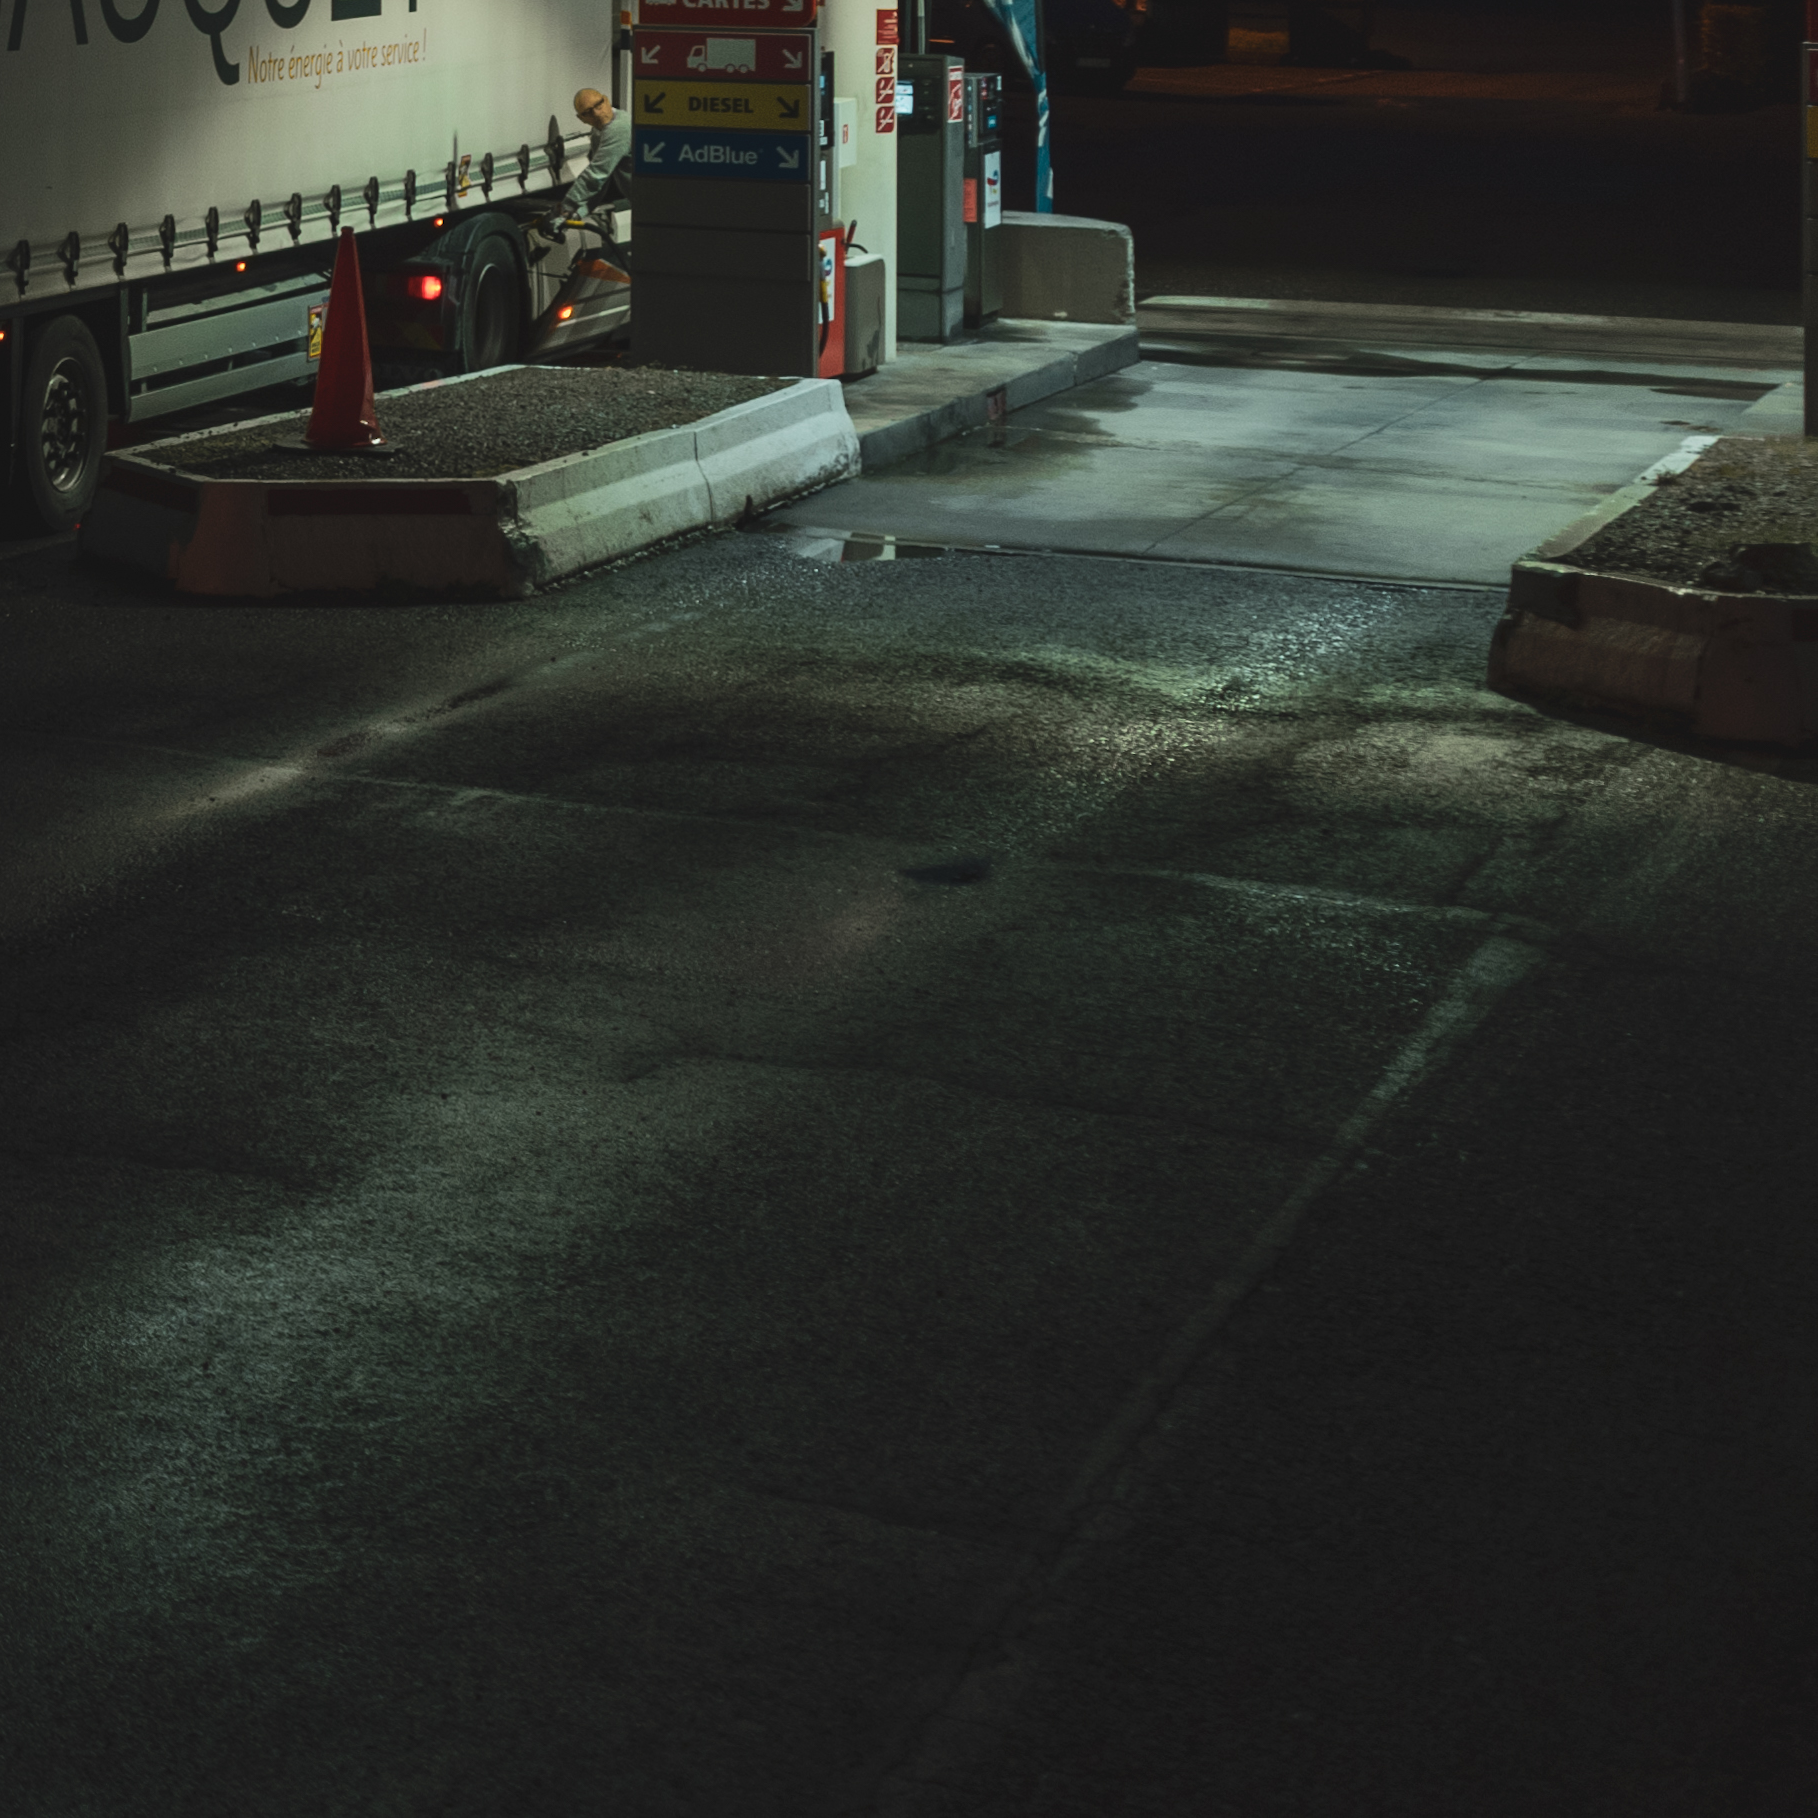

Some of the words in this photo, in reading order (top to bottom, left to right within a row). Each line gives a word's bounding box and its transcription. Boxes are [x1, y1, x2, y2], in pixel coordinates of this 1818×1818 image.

[248, 44, 285, 84] Notre
[288, 43, 333, 90] énergie
[336, 39, 344, 73] à
[347, 40, 378, 71] votre
[381, 33, 420, 67] service
[687, 96, 754, 114] DIESEL
[678, 143, 759, 165] AdBlue
